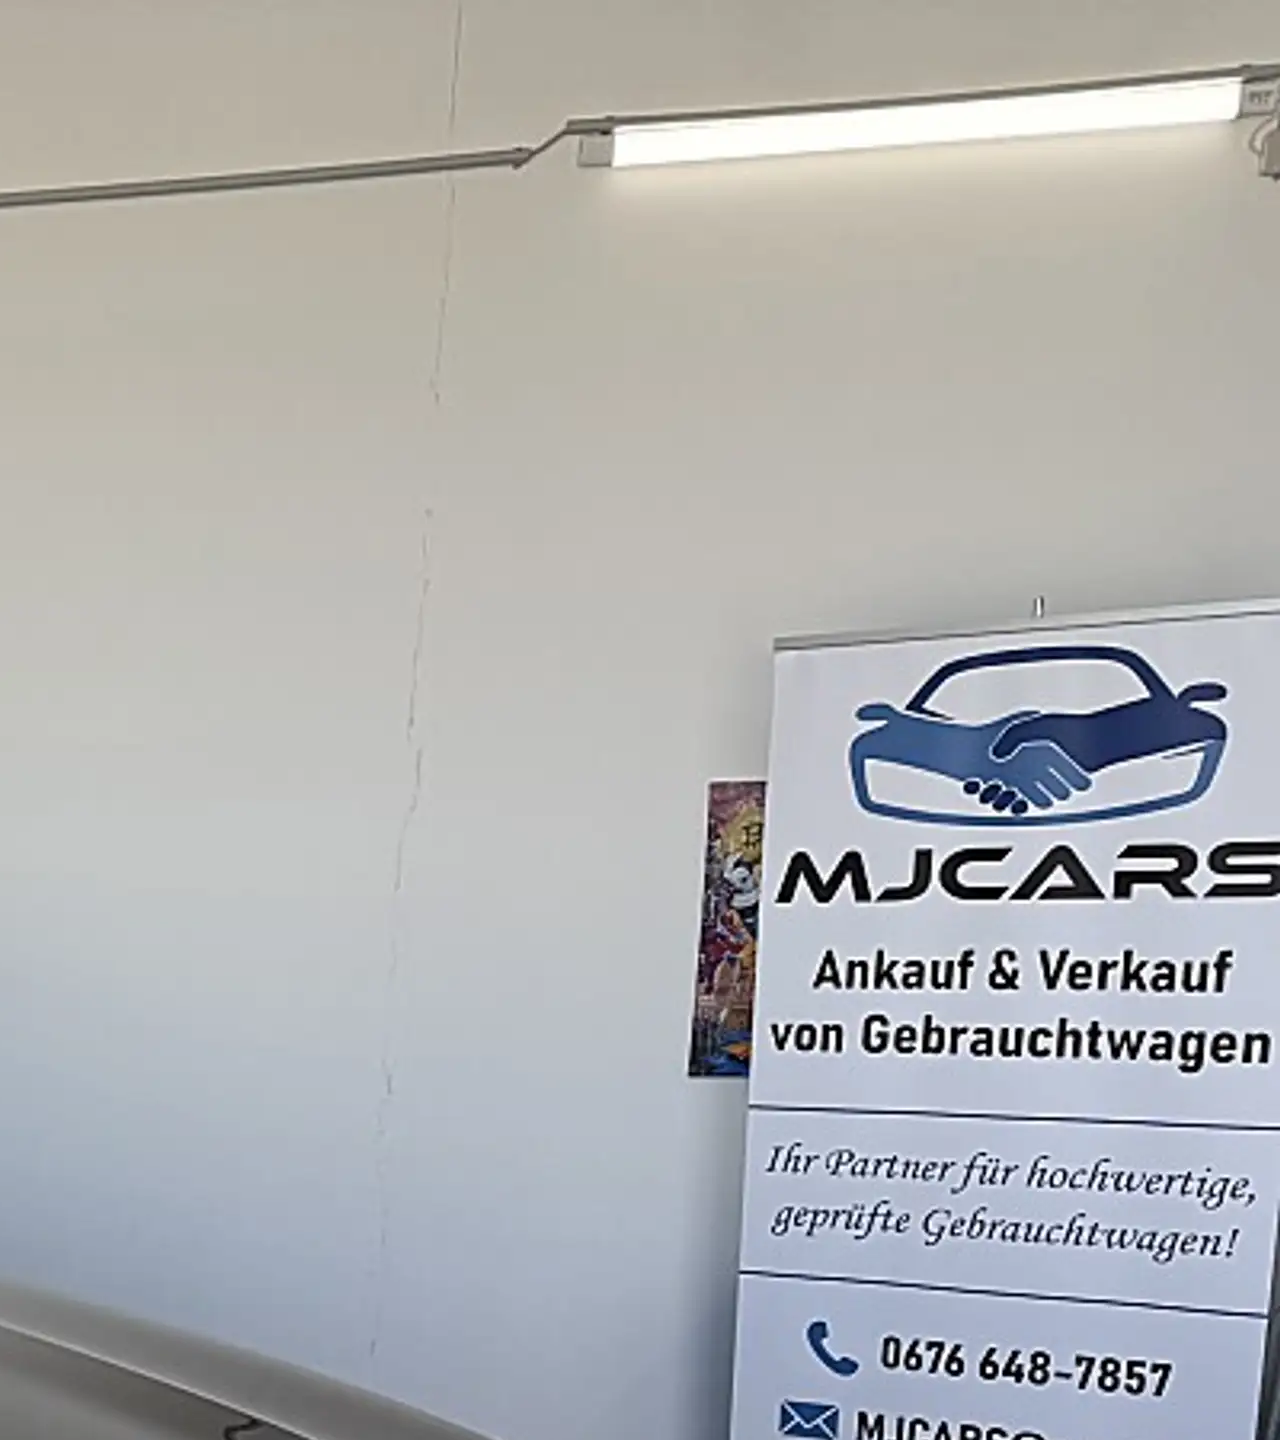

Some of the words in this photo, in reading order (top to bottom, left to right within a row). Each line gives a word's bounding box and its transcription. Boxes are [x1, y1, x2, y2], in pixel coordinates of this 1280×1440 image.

[775, 841, 1280, 904] MJCARS
[813, 949, 975, 990] Ankauf
[988, 949, 1019, 990] &
[1039, 949, 1234, 993] Verkauf
[771, 1022, 843, 1053] von
[861, 1014, 1271, 1073] Gebrauchtwagen
[766, 1142, 820, 1174] Ihr
[825, 1148, 955, 1184] Partner
[946, 1151, 1020, 1196] für
[1026, 1154, 1257, 1210] hochwertige,
[770, 1199, 911, 1240] geprüfte
[922, 1204, 1240, 1263] Gebrauchtwagen!
[881, 1336, 965, 1377] 0676
[978, 1347, 1173, 1398] 648-7857
